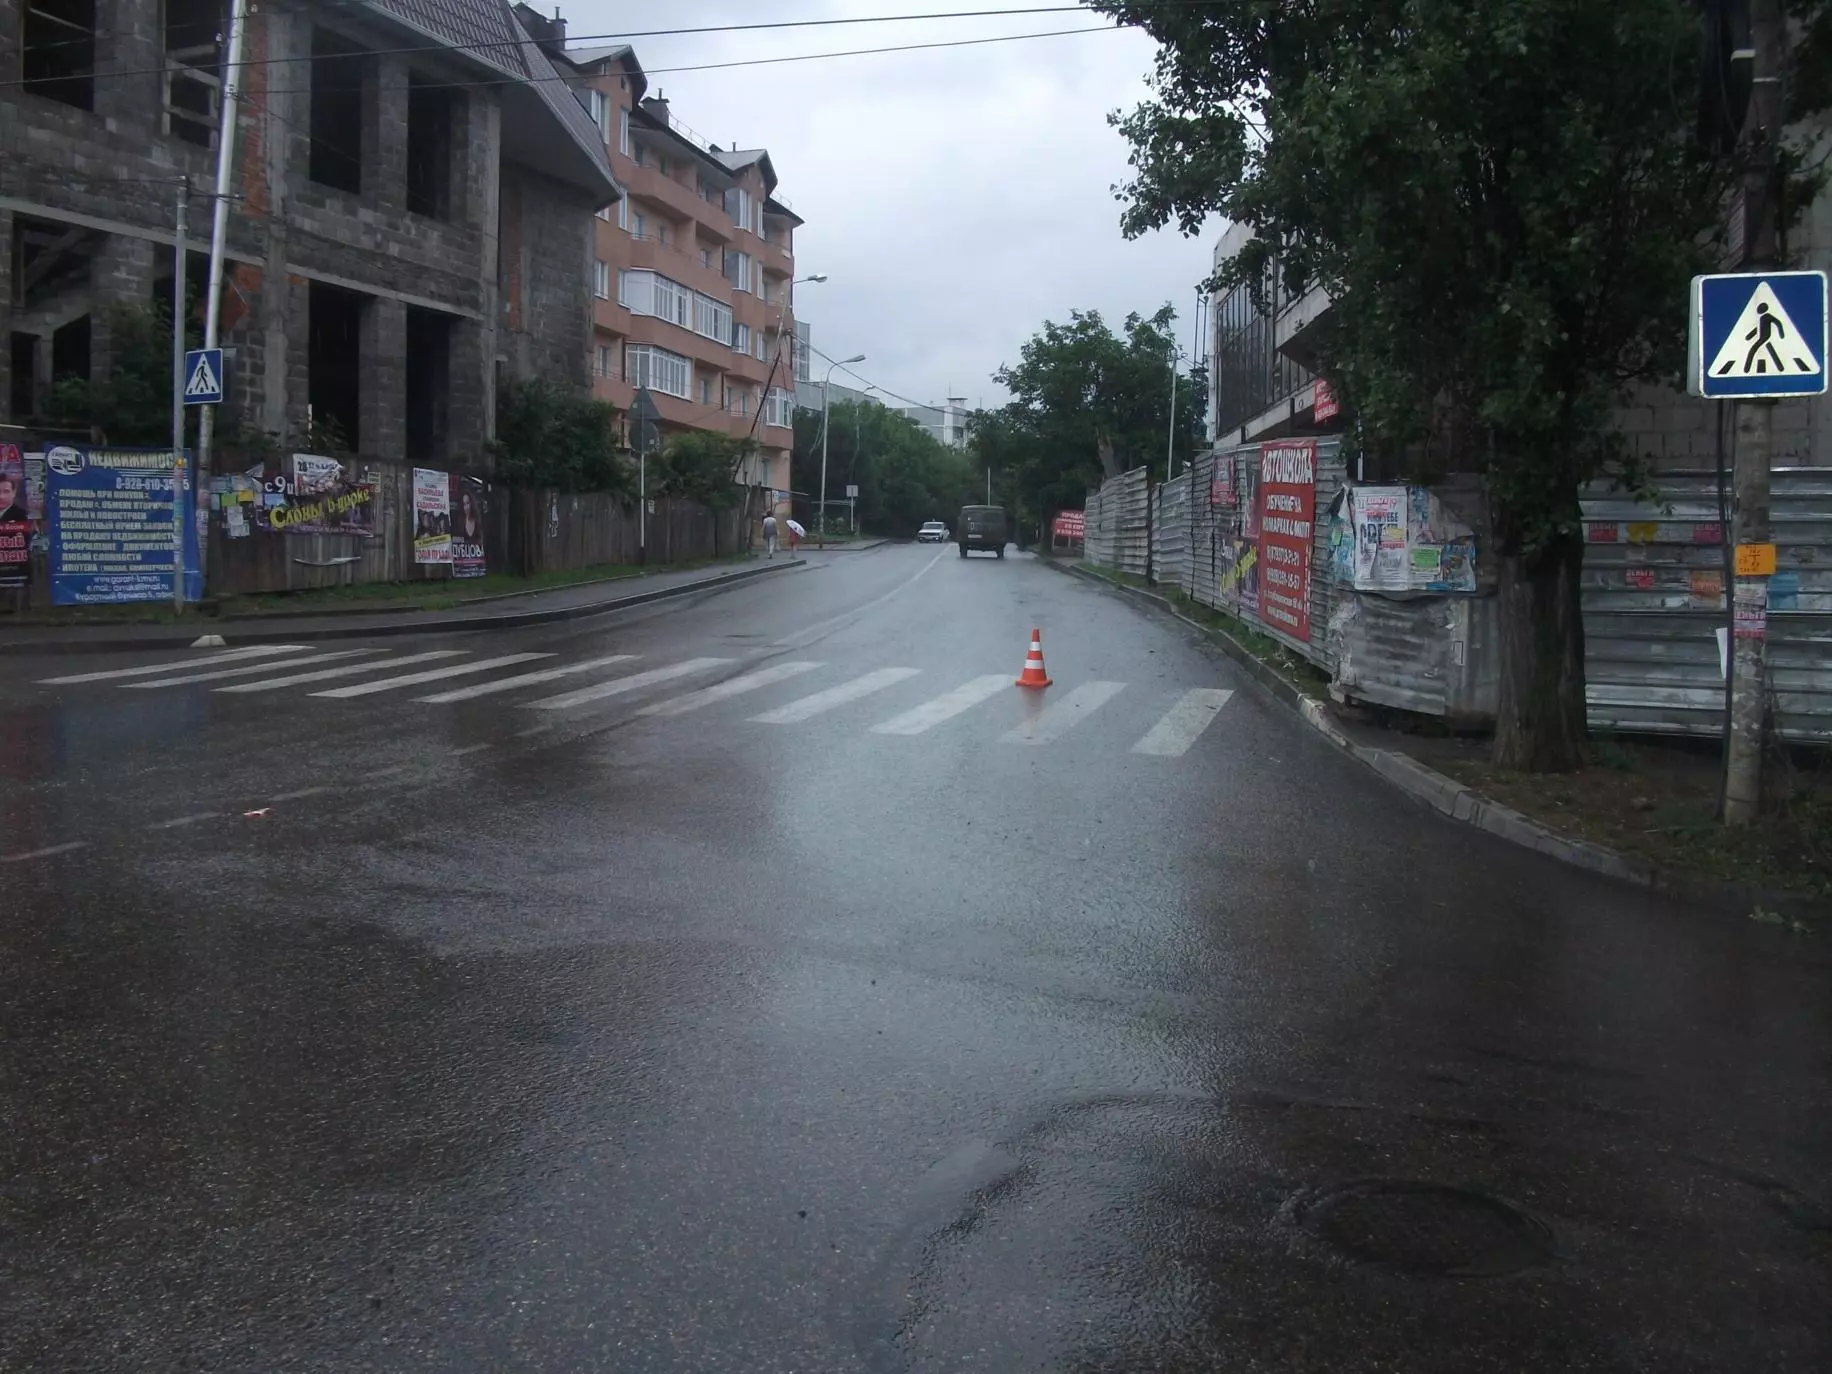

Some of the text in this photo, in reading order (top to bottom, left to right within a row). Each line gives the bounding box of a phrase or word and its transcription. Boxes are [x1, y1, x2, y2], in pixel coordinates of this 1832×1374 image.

[88, 451, 188, 469] НЕДВИЖИМОС
[1263, 448, 1313, 485] АВТОШКОЛА
[274, 476, 287, 493] 9
[270, 503, 324, 528] Слоны
